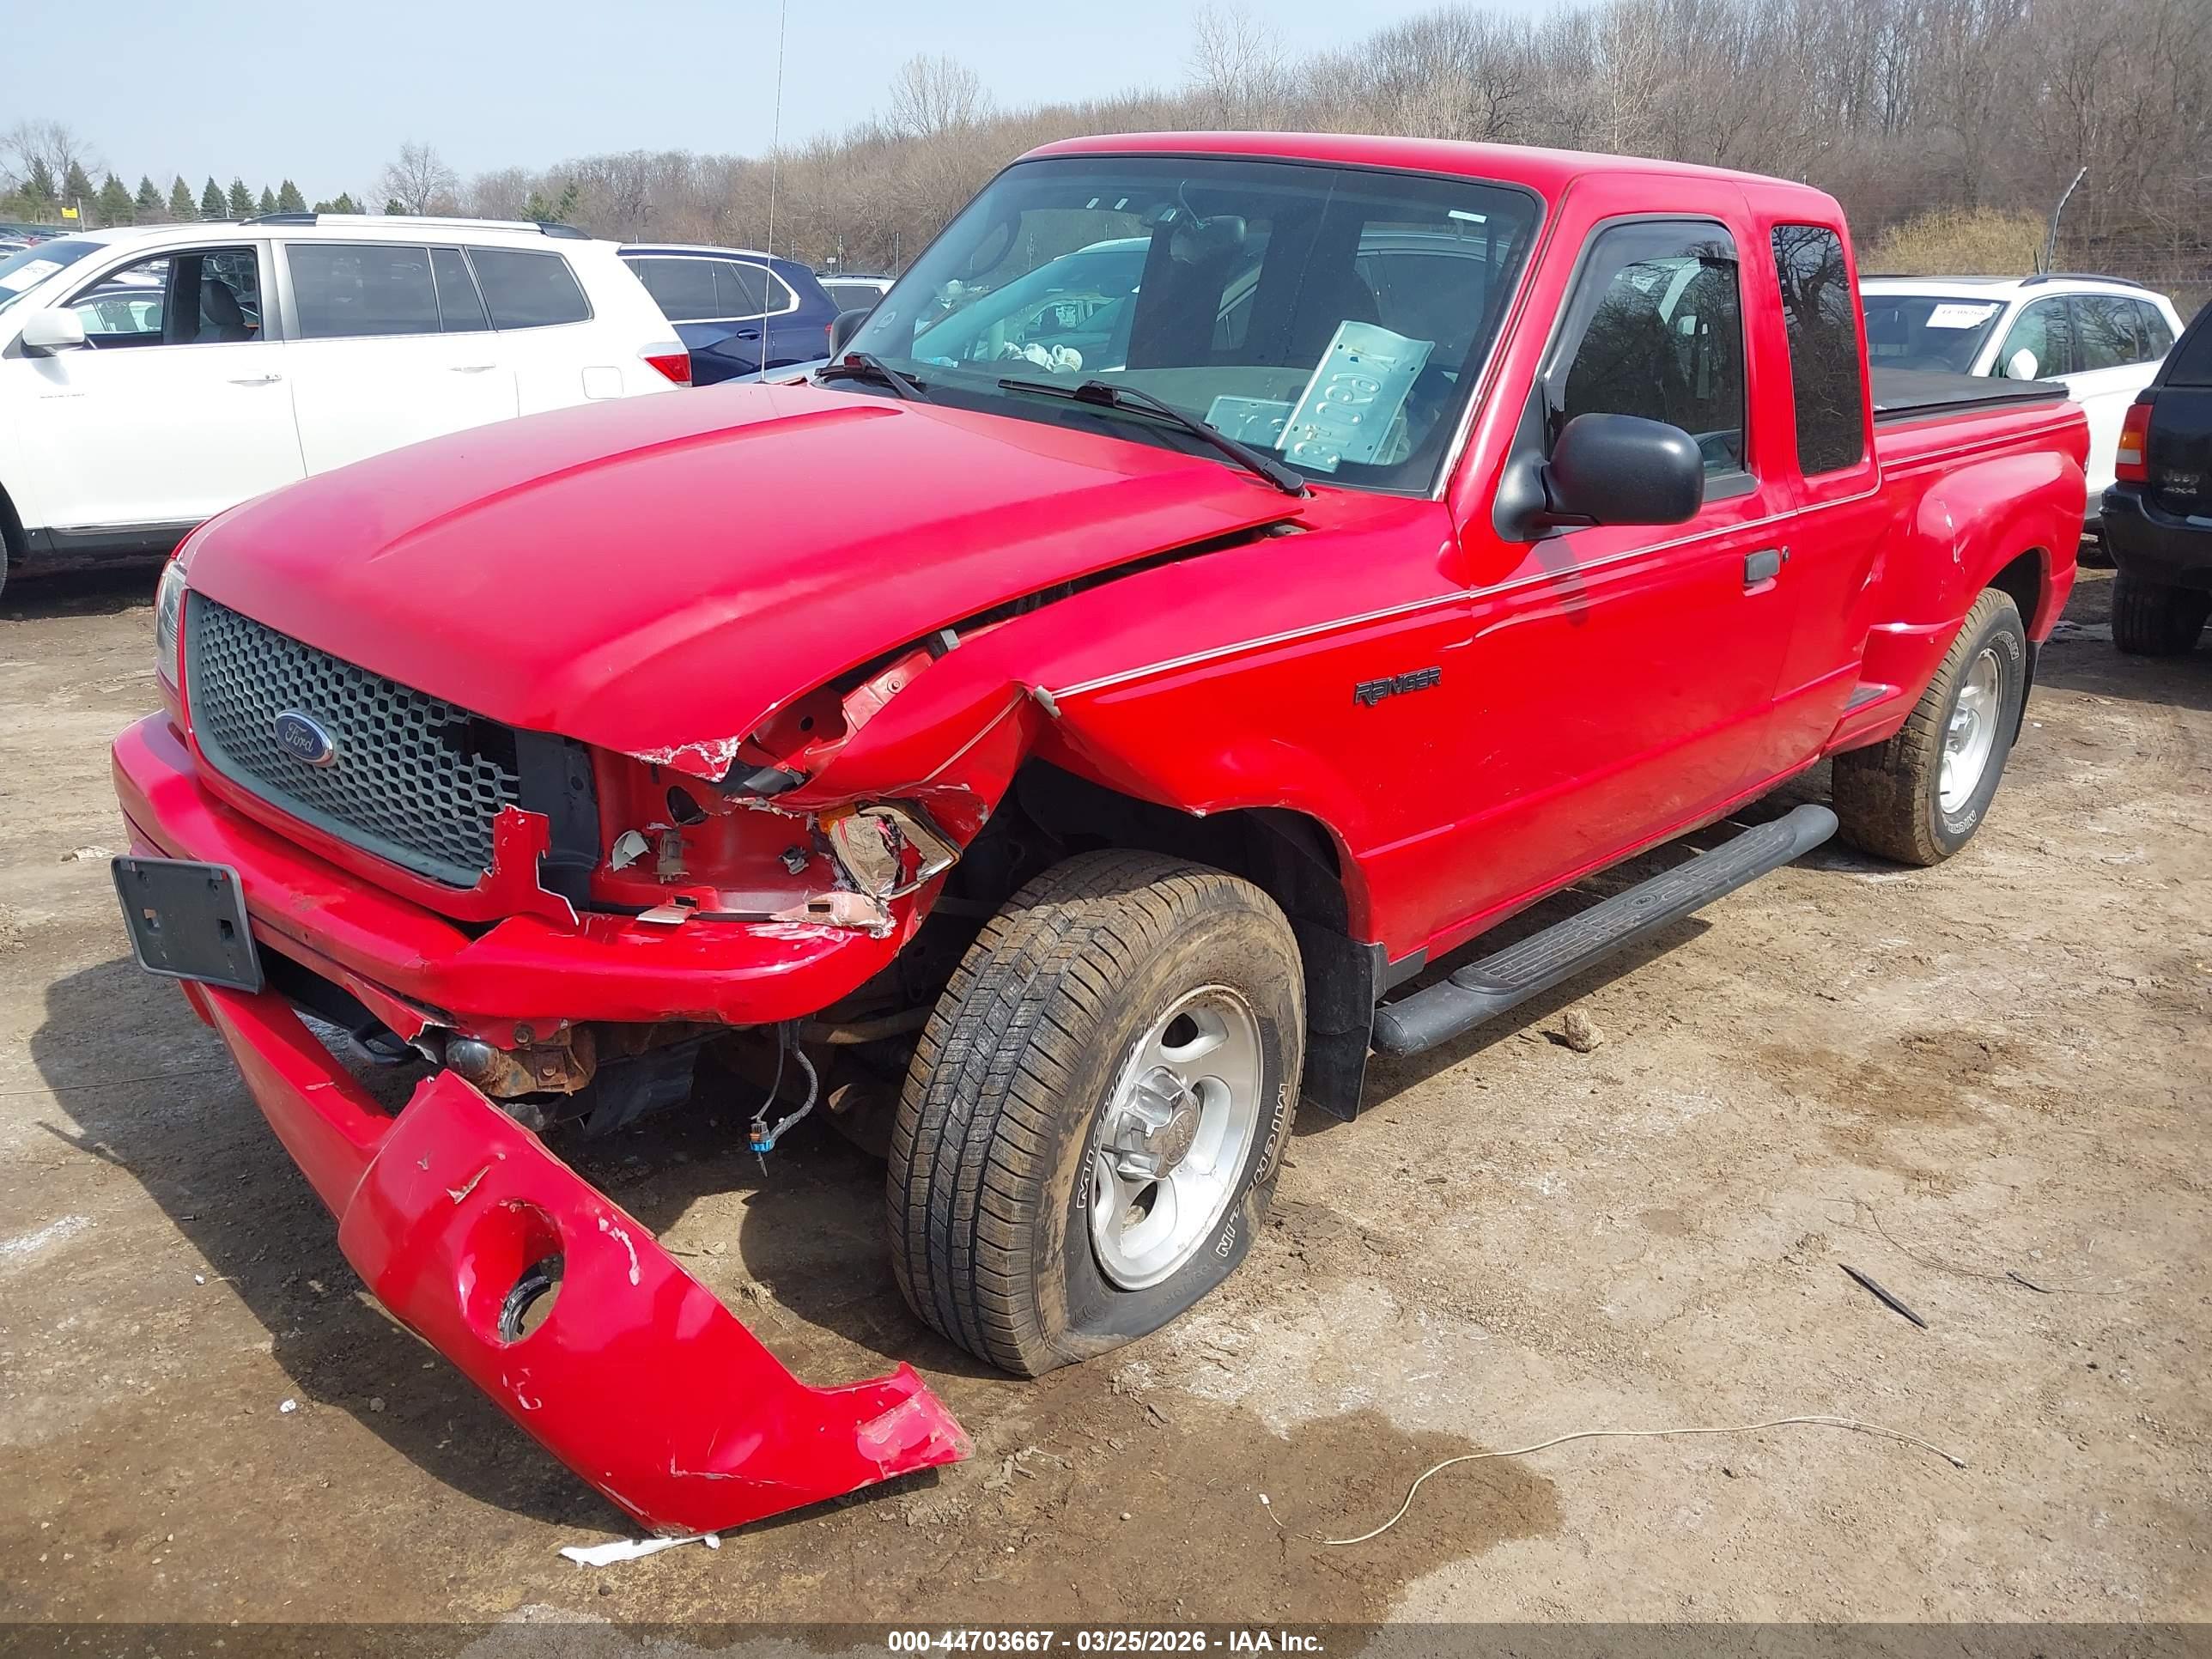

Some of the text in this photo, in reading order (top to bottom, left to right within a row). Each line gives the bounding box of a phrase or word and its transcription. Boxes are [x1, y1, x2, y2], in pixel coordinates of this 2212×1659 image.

[2163, 469, 2199, 485] Jeep
[1354, 665, 1442, 706] RANGER
[285, 722, 314, 752] Ford
